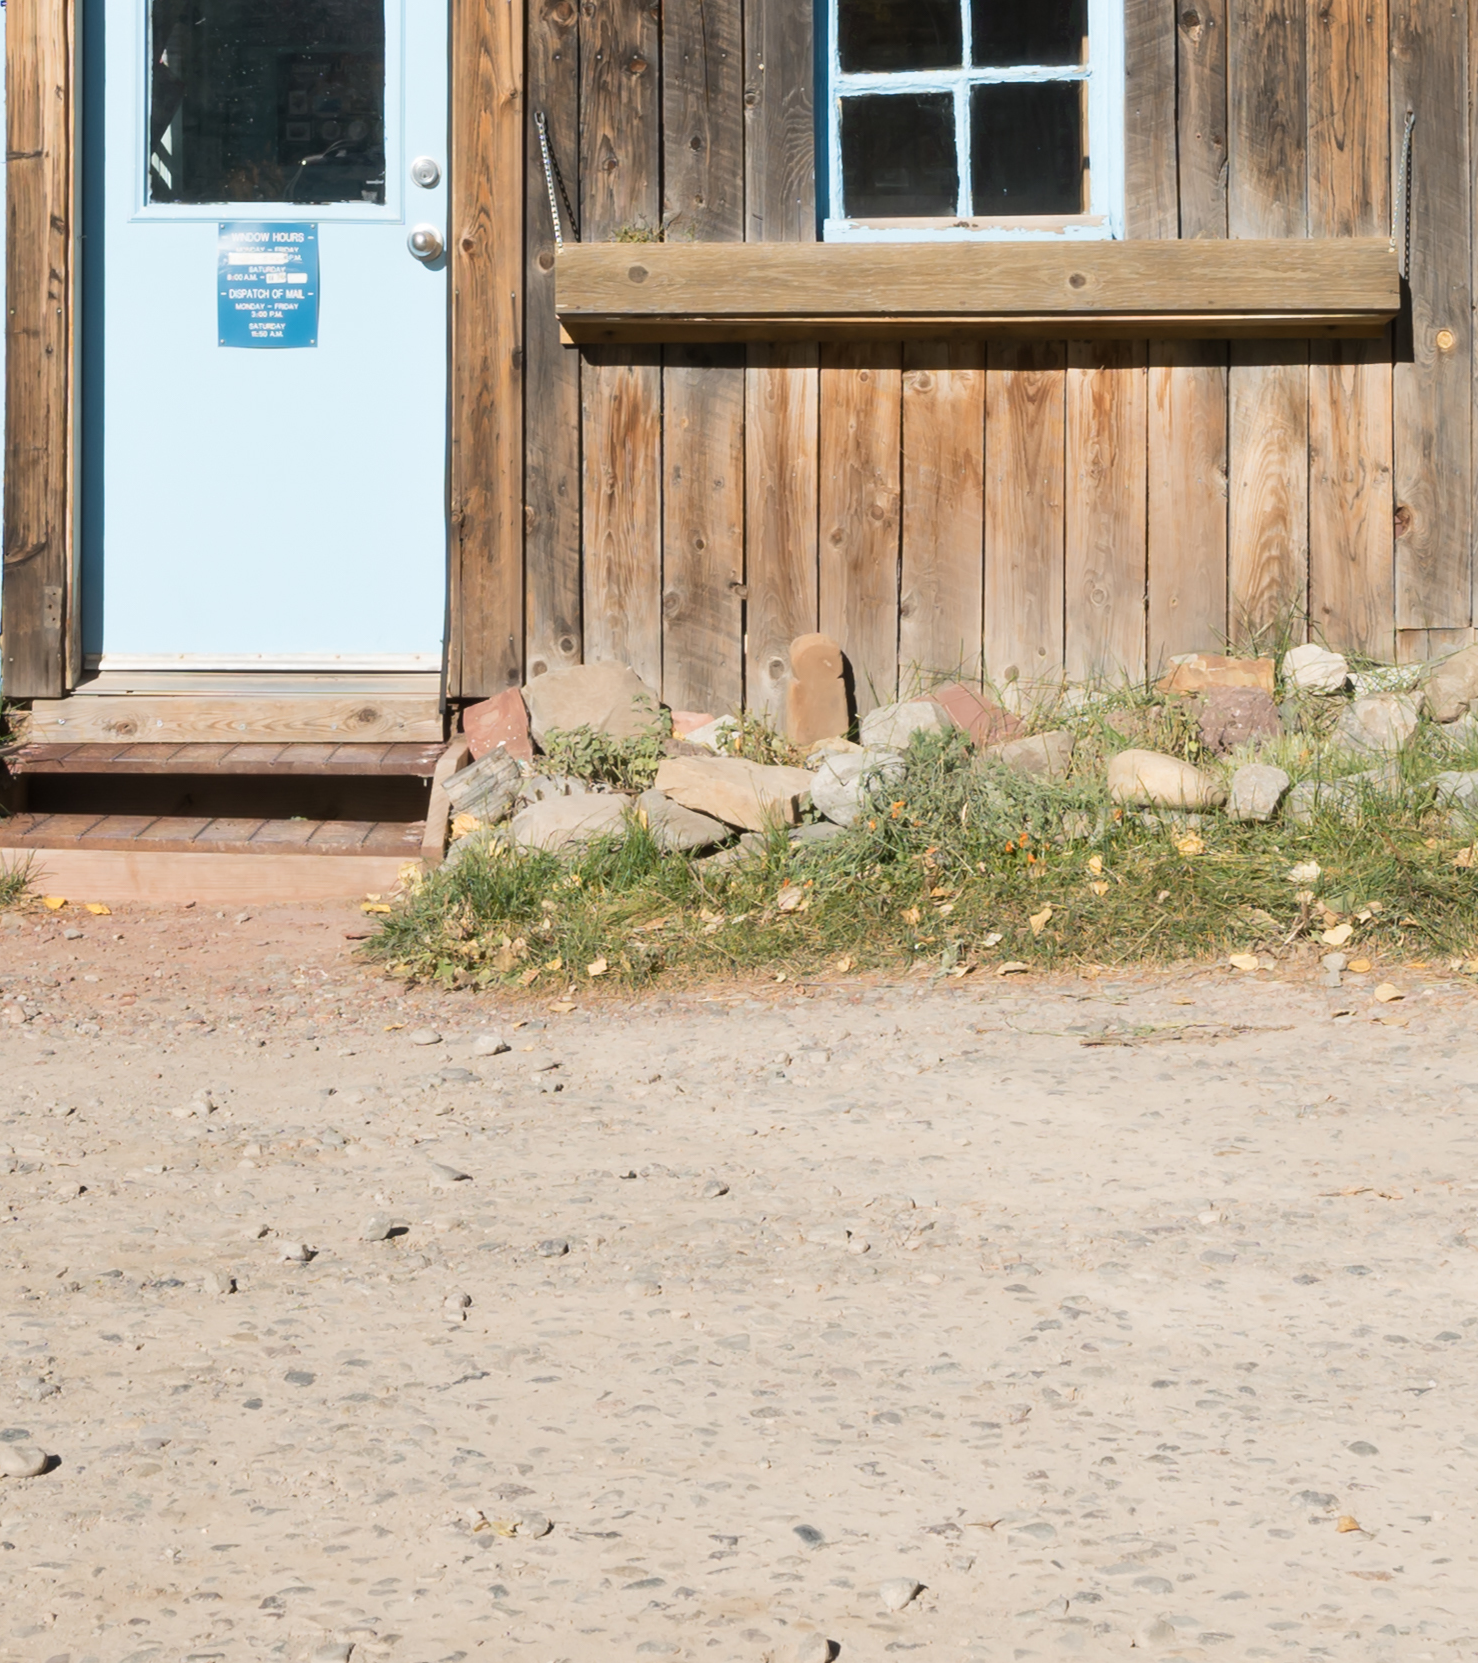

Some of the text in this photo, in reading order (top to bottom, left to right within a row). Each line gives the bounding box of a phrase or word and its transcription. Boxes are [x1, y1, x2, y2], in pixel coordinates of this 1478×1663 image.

[231, 232, 305, 242] WINDOW HOURS
[228, 289, 305, 299] DISPATCH OF MAIL
